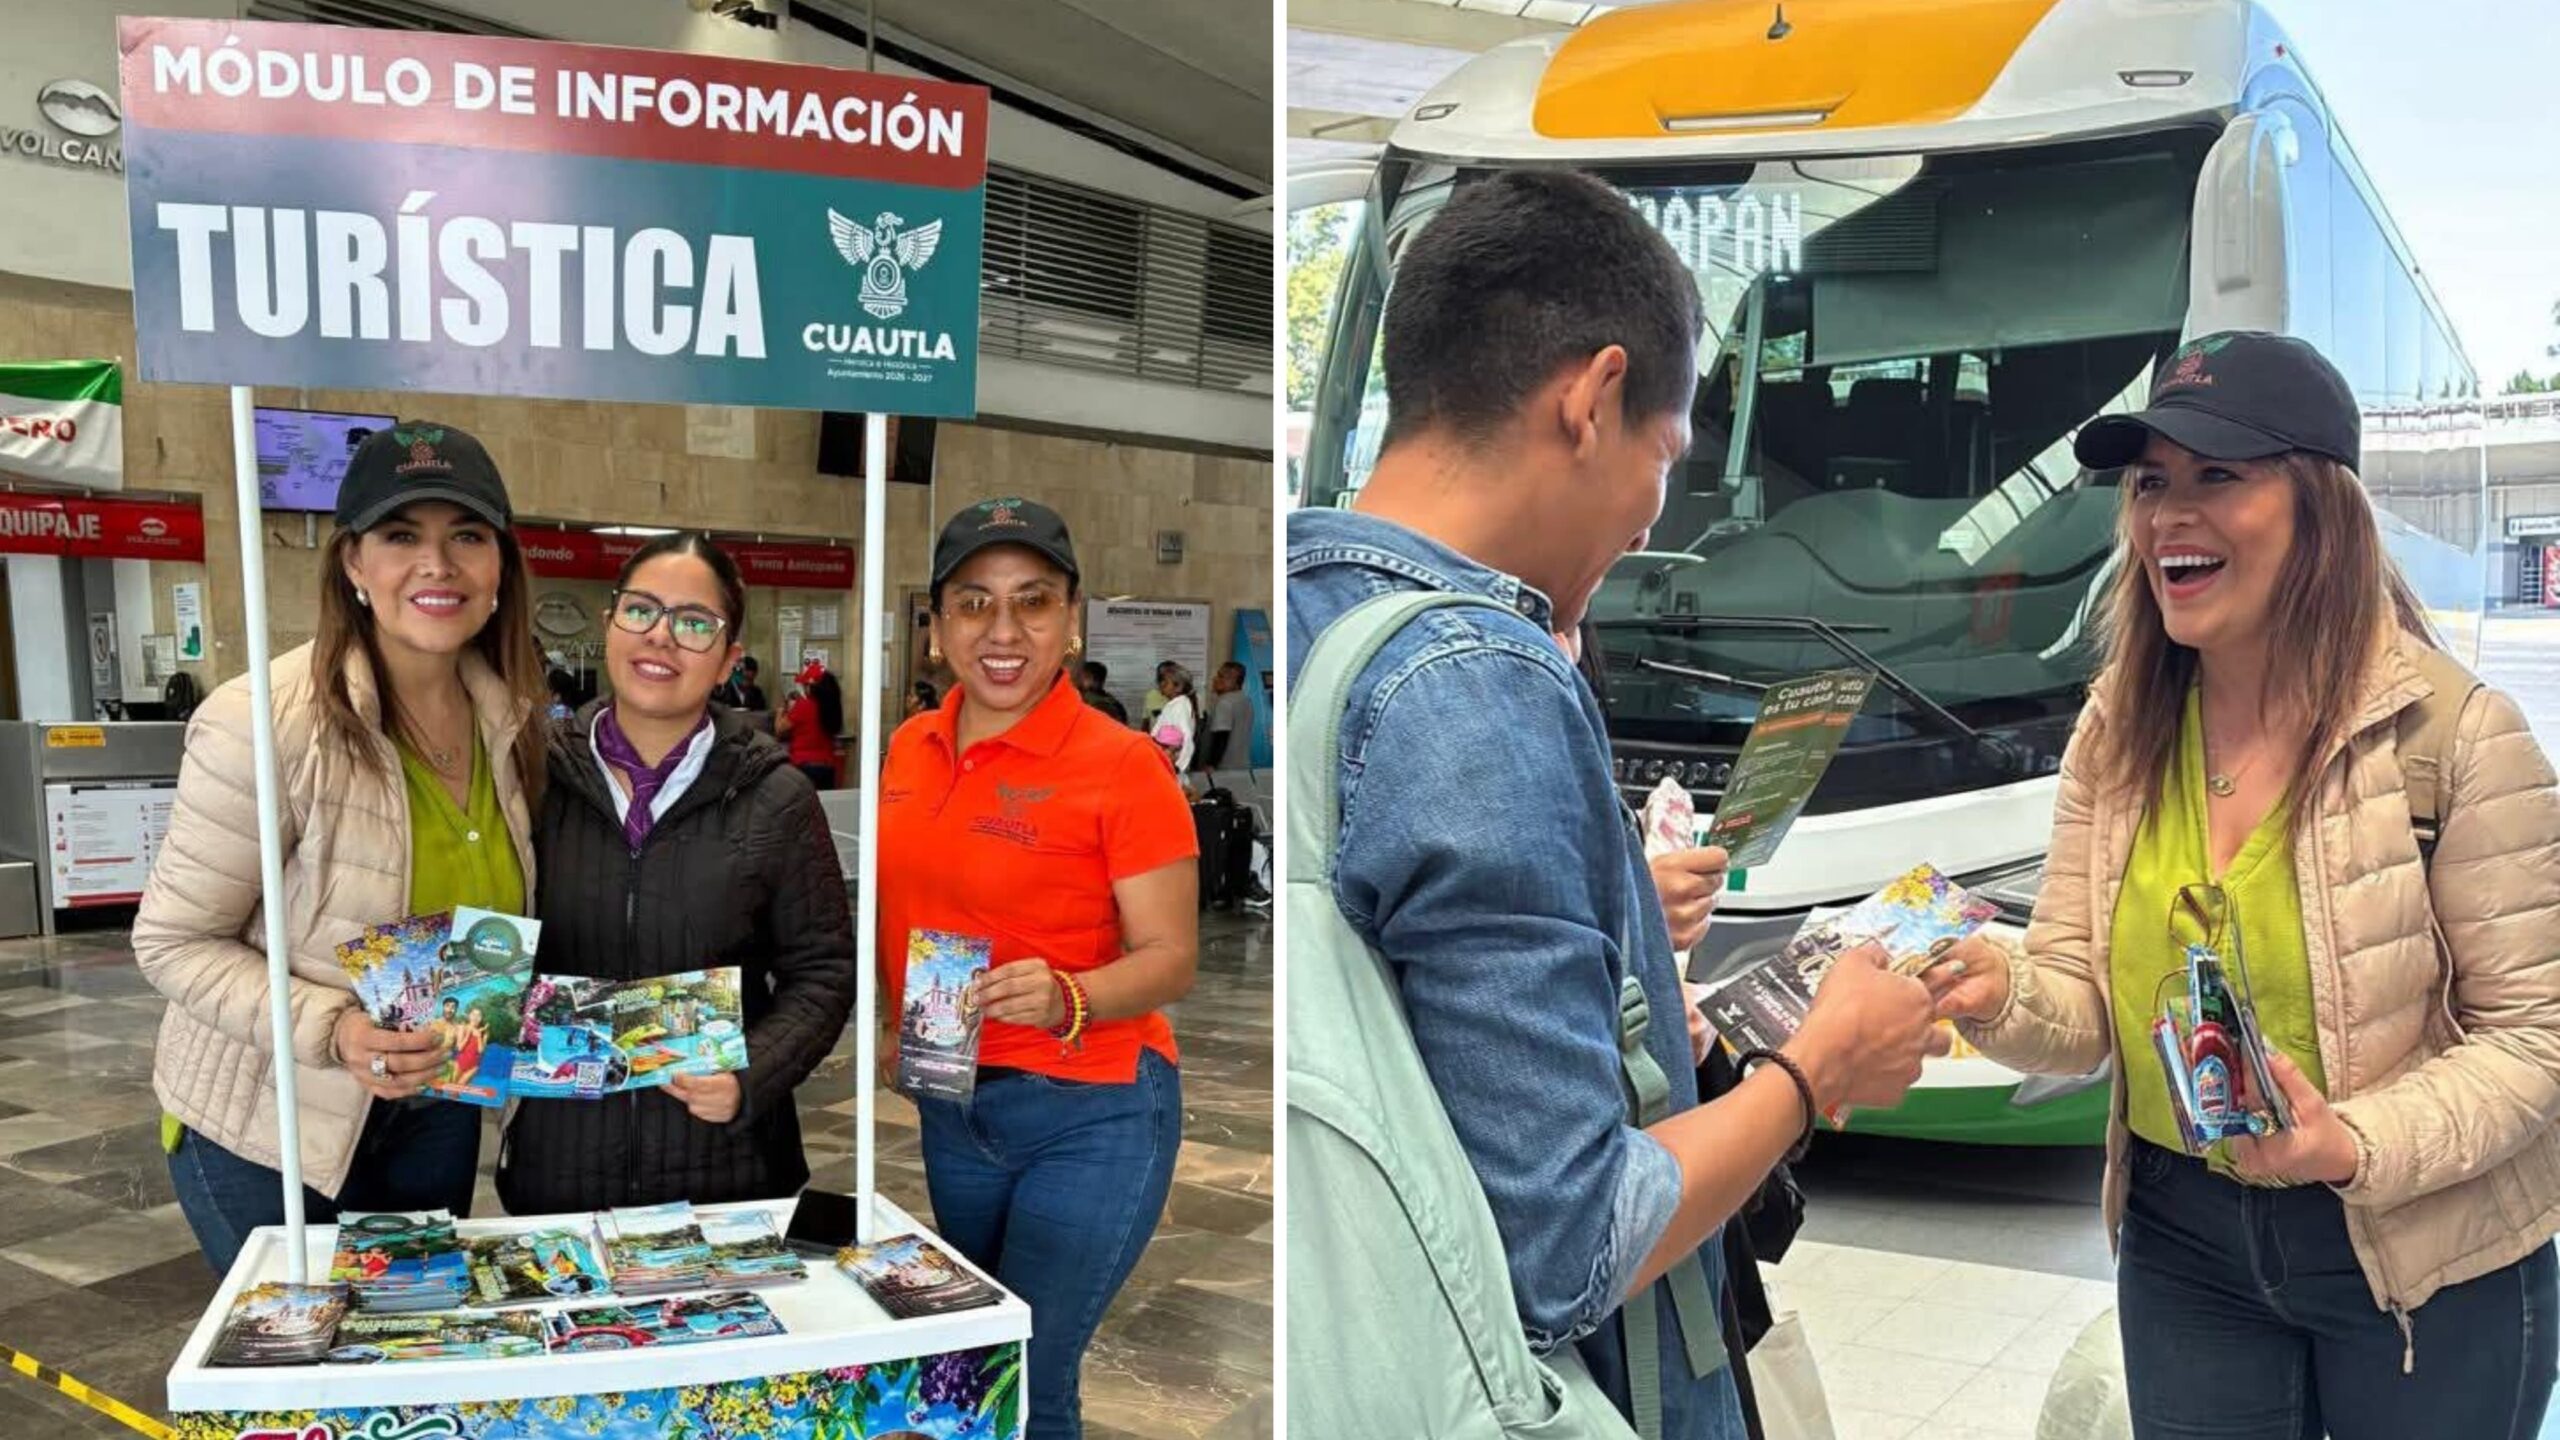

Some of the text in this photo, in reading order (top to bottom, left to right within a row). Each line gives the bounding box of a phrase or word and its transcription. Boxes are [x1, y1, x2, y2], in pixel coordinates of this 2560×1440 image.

[152, 34, 963, 157] MÓDULO DE INFORMACIÓN
[157, 190, 767, 359] TURÍSTICA
[802, 322, 957, 361] CUAUTLA
[827, 368, 884, 380] Ayuntamiento
